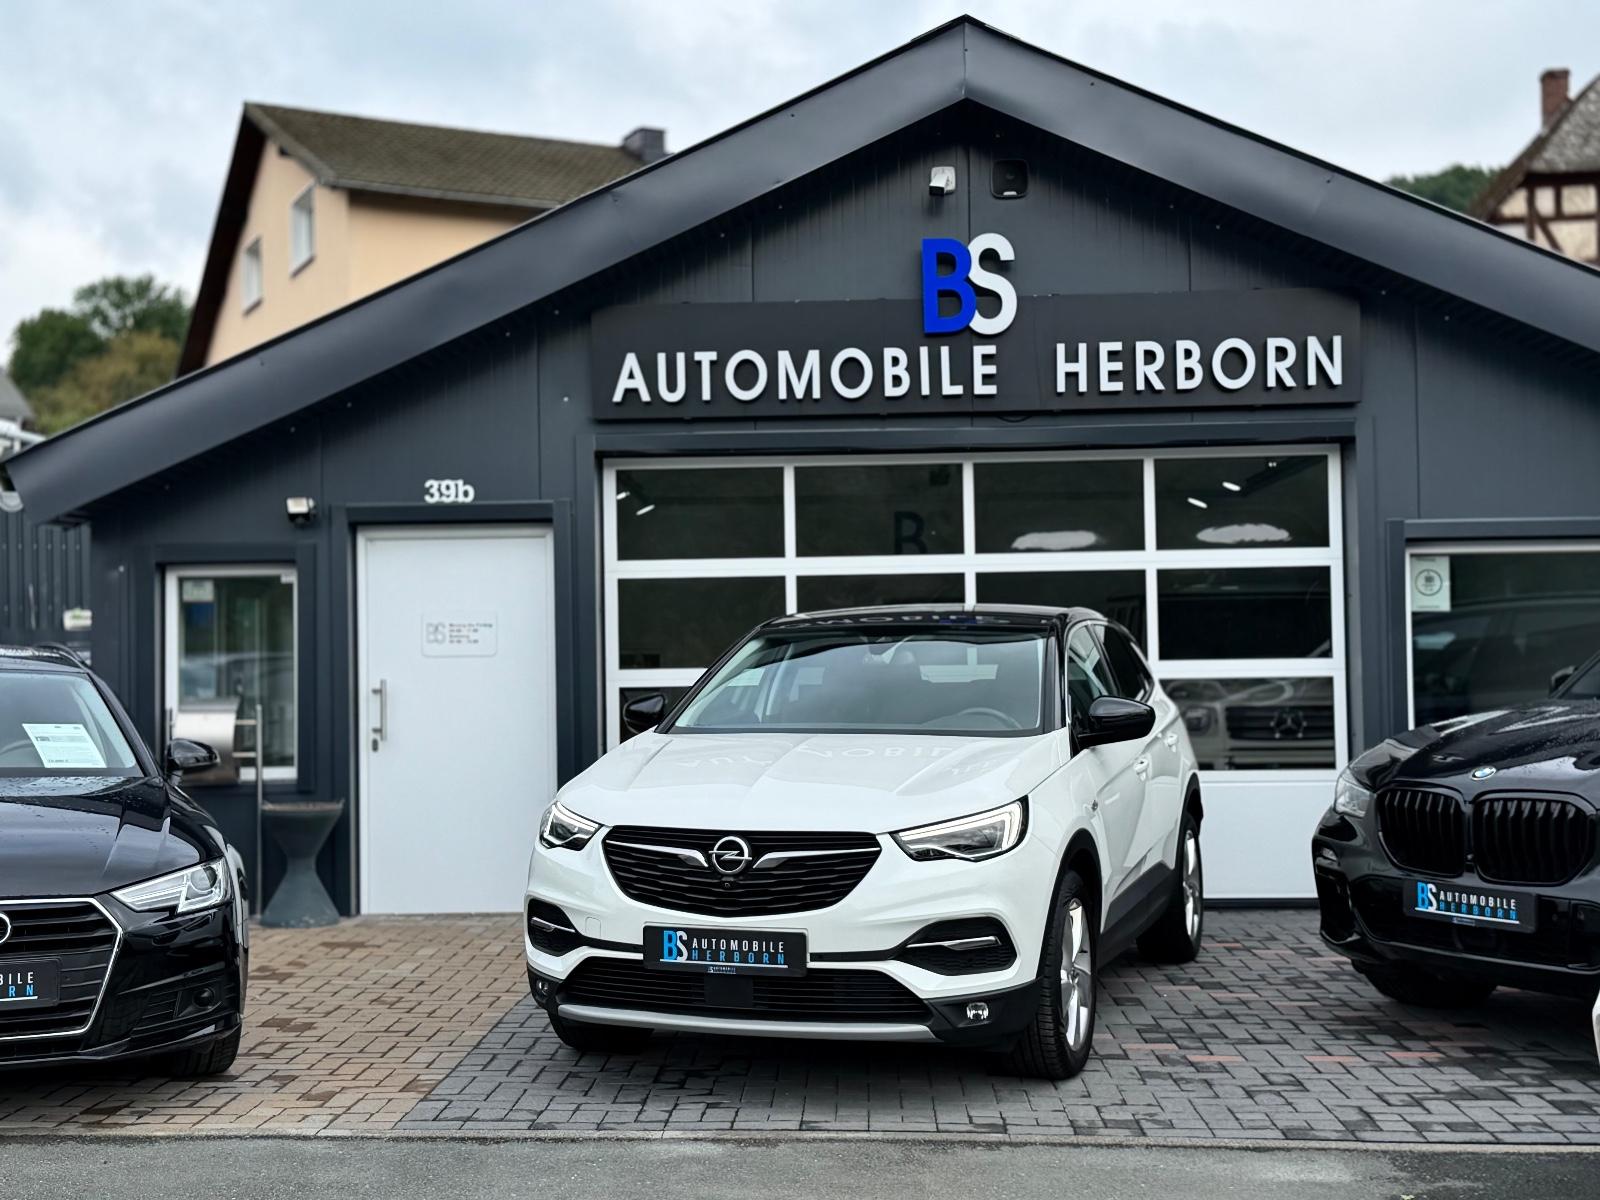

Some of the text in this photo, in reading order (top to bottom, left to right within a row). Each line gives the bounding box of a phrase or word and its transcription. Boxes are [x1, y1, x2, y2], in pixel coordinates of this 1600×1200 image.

[922, 233, 1018, 335] BS
[612, 335, 1343, 403] AUTOMOBILE HERBORN
[424, 479, 475, 503] 39b
[1417, 881, 1437, 911] BS
[1440, 890, 1516, 910] AUTOMOBILE
[663, 930, 688, 961] BS
[692, 937, 785, 953] AUTOMOBILE
[692, 949, 785, 964] HERBORN
